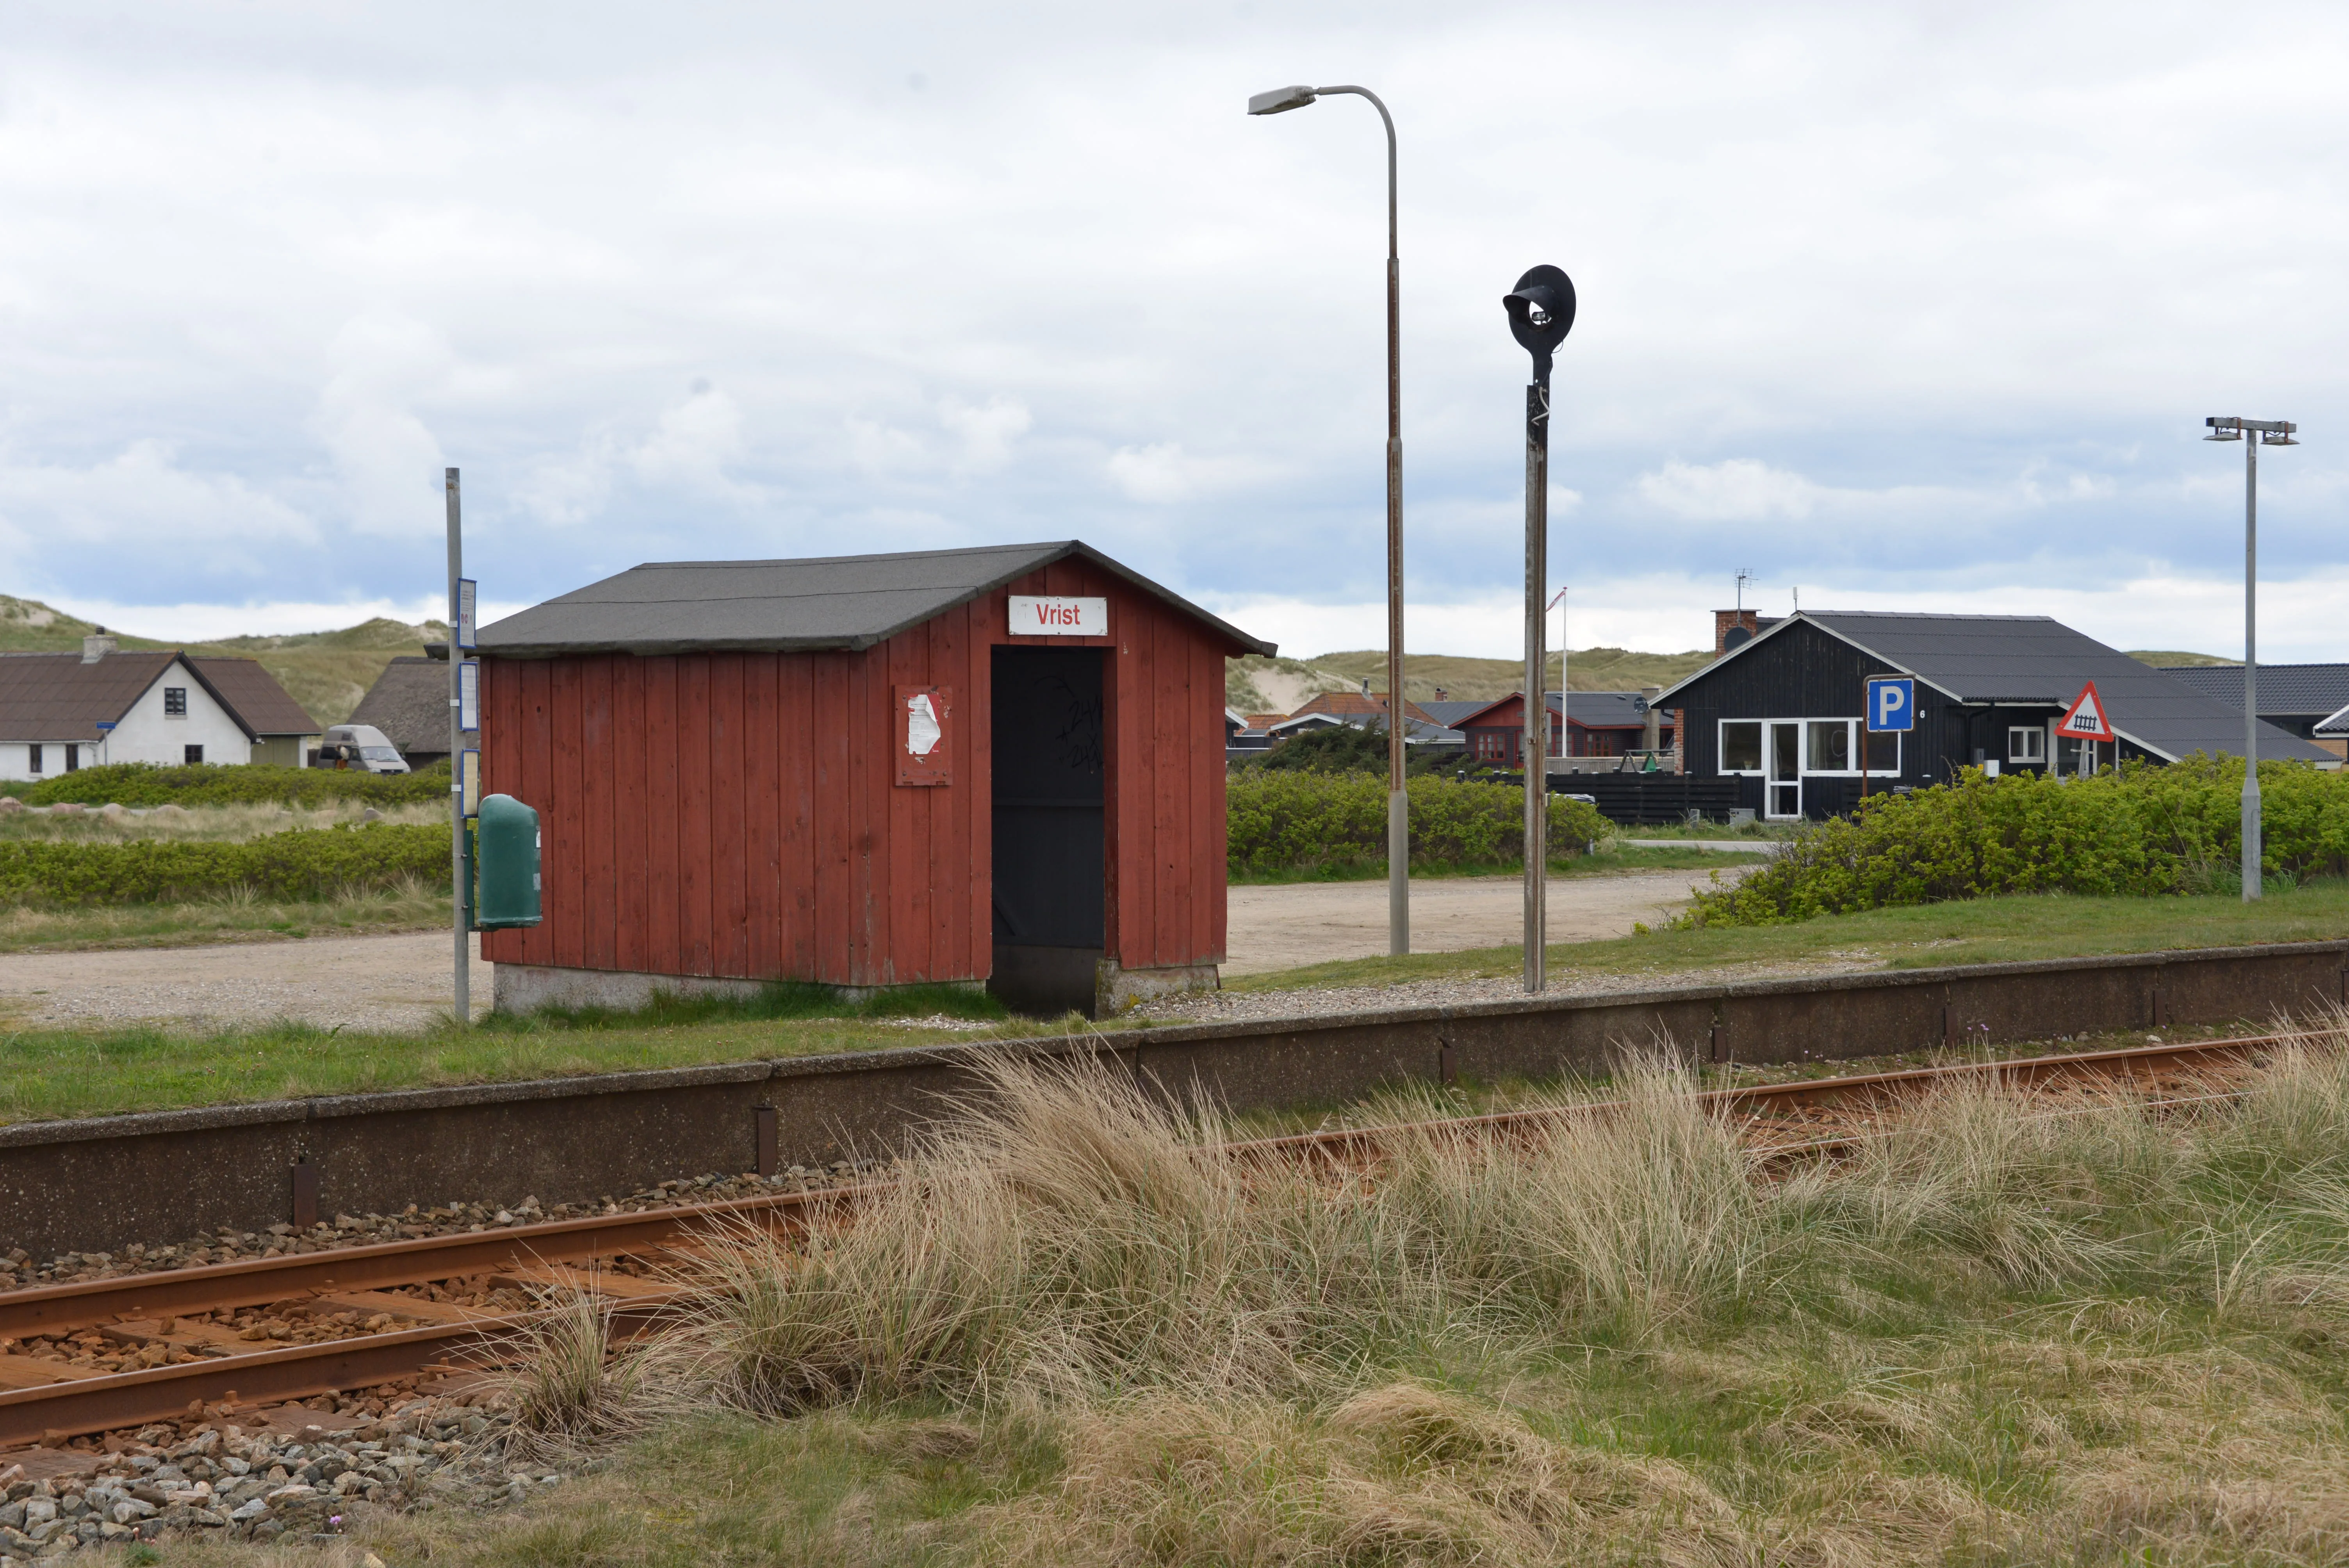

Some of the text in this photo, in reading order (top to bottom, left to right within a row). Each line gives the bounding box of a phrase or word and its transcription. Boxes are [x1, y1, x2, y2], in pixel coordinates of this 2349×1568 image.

[1037, 604, 1080, 625] Vrist
[1880, 686, 1904, 725] P
[1920, 710, 1925, 718] 6
